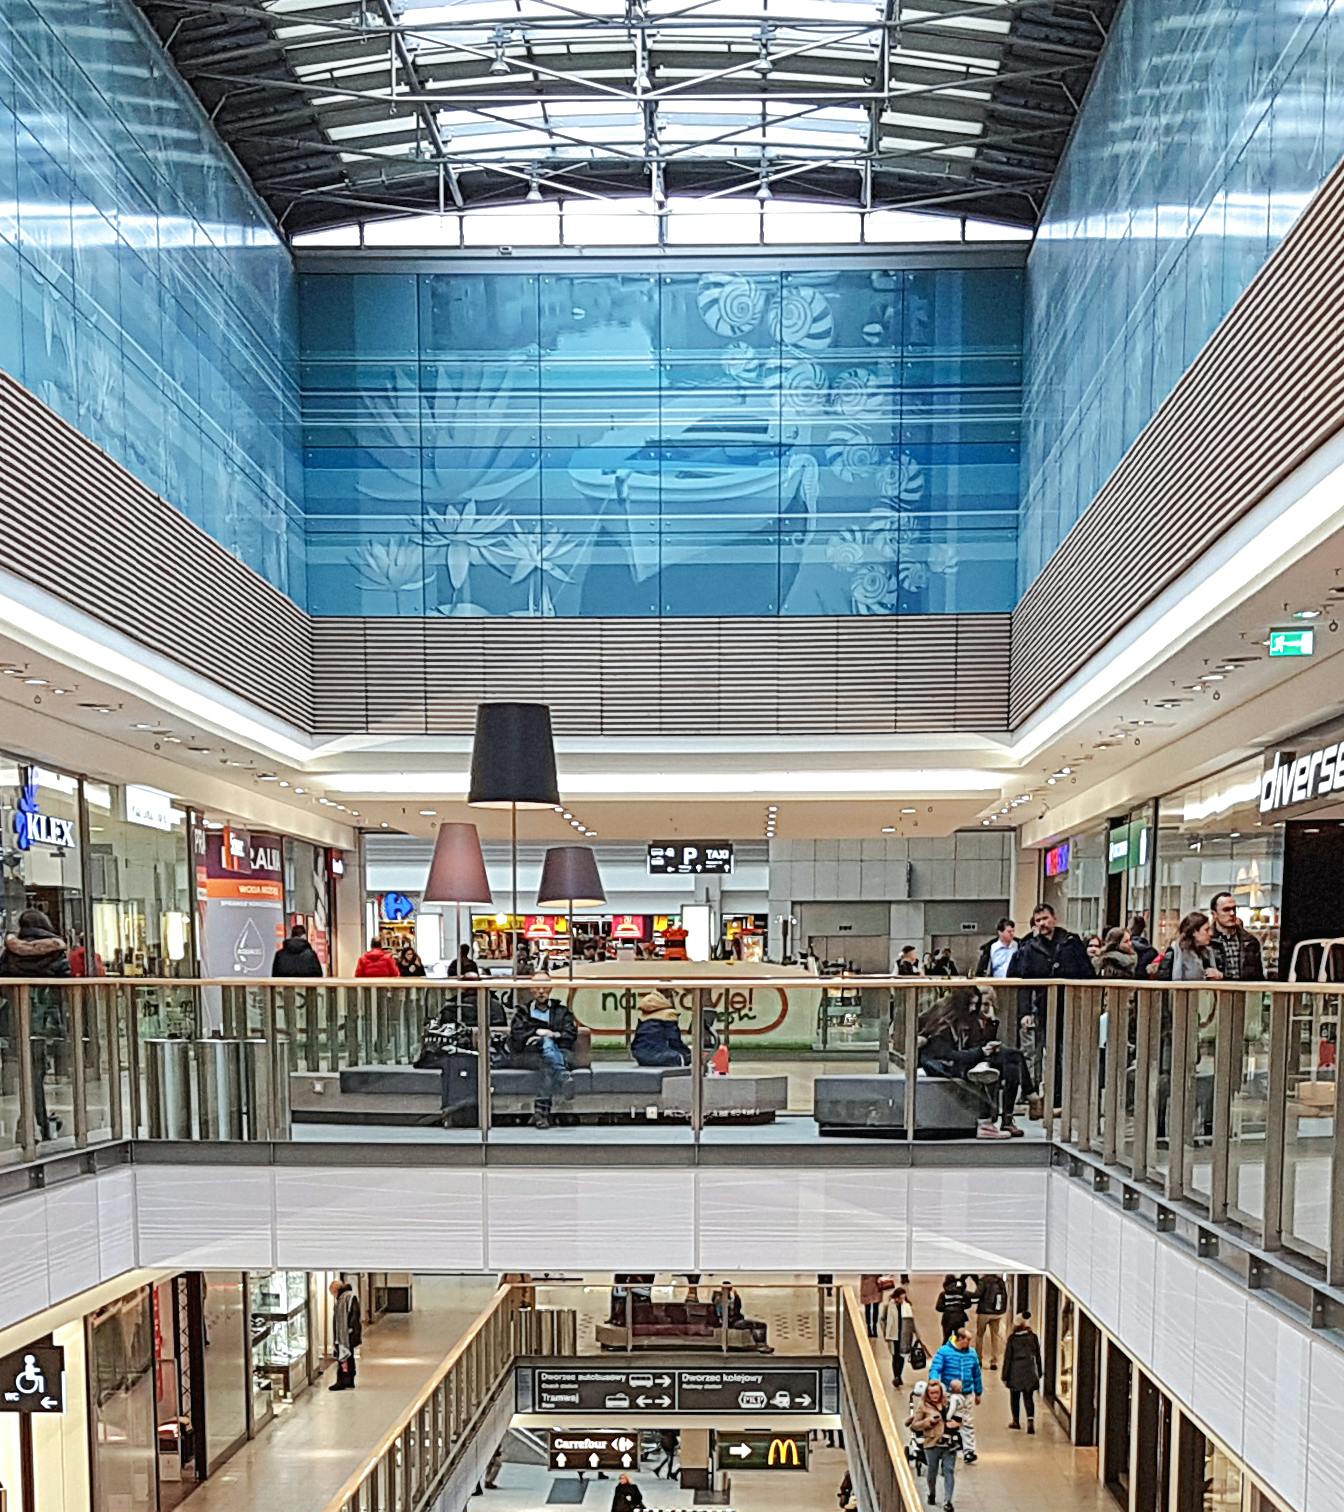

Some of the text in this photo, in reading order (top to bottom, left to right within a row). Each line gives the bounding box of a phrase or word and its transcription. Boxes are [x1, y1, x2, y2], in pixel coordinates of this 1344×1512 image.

[25, 811, 76, 848] KLEX
[682, 847, 698, 865] P
[705, 849, 730, 860] TAXI
[681, 1373, 763, 1384] Dworzec kolejowy
[4, 1391, 20, 1401] WC
[554, 1437, 608, 1450] Carrefour
